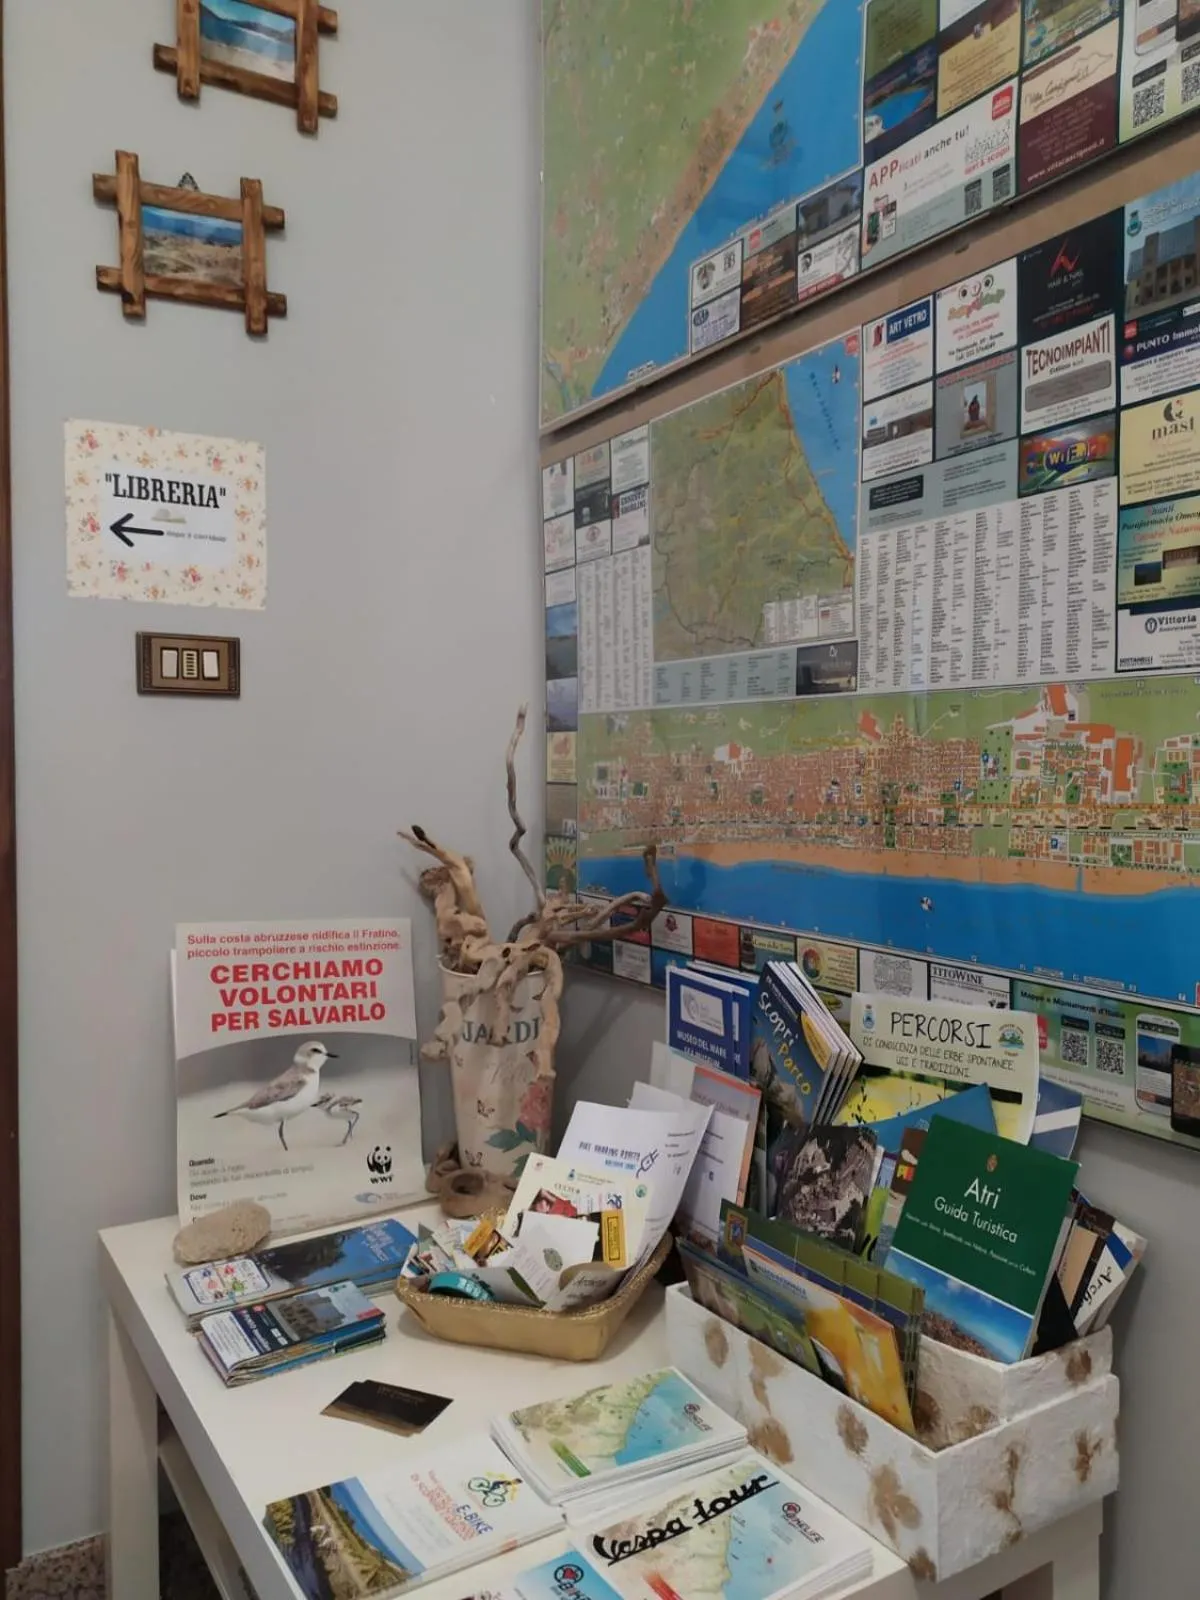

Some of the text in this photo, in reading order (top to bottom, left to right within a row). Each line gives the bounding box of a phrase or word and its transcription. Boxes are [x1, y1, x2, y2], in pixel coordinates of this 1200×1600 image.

[924, 136, 951, 159] anche
[889, 310, 927, 335] ART VETRO
[1026, 320, 1110, 378] TECNOIMPIANTI
[1137, 335, 1170, 353] PUNTO
[105, 472, 226, 508] "LIBRERIA"
[1158, 614, 1197, 626] Vittoria
[187, 934, 216, 944] Sulla
[219, 933, 251, 944] costa
[254, 931, 309, 942] abruzzese
[312, 928, 350, 940] nidifica
[187, 947, 230, 959] piccolo
[233, 945, 296, 957] trampoliere
[309, 943, 344, 953] rischio
[210, 958, 384, 984] CERCHIAMO
[220, 981, 377, 1007] VOLONTARI
[211, 1002, 386, 1032] PER SALVARLO
[758, 991, 799, 1048] Scopri
[890, 1011, 993, 1049] PERCORSI
[863, 1036, 873, 1047] DI
[875, 1039, 918, 1055] CONOSCENZA
[920, 1045, 942, 1060] DELLE
[943, 1049, 965, 1062] ERBE
[919, 1060, 971, 1078] TRADIZIONI
[370, 1175, 394, 1185] WWF
[964, 1177, 1001, 1209] Atri
[934, 1196, 969, 1223] Guida
[972, 1211, 1018, 1244] Turistica
[456, 1504, 494, 1535] E-BIKE
[592, 1474, 780, 1568] Vespa tour
